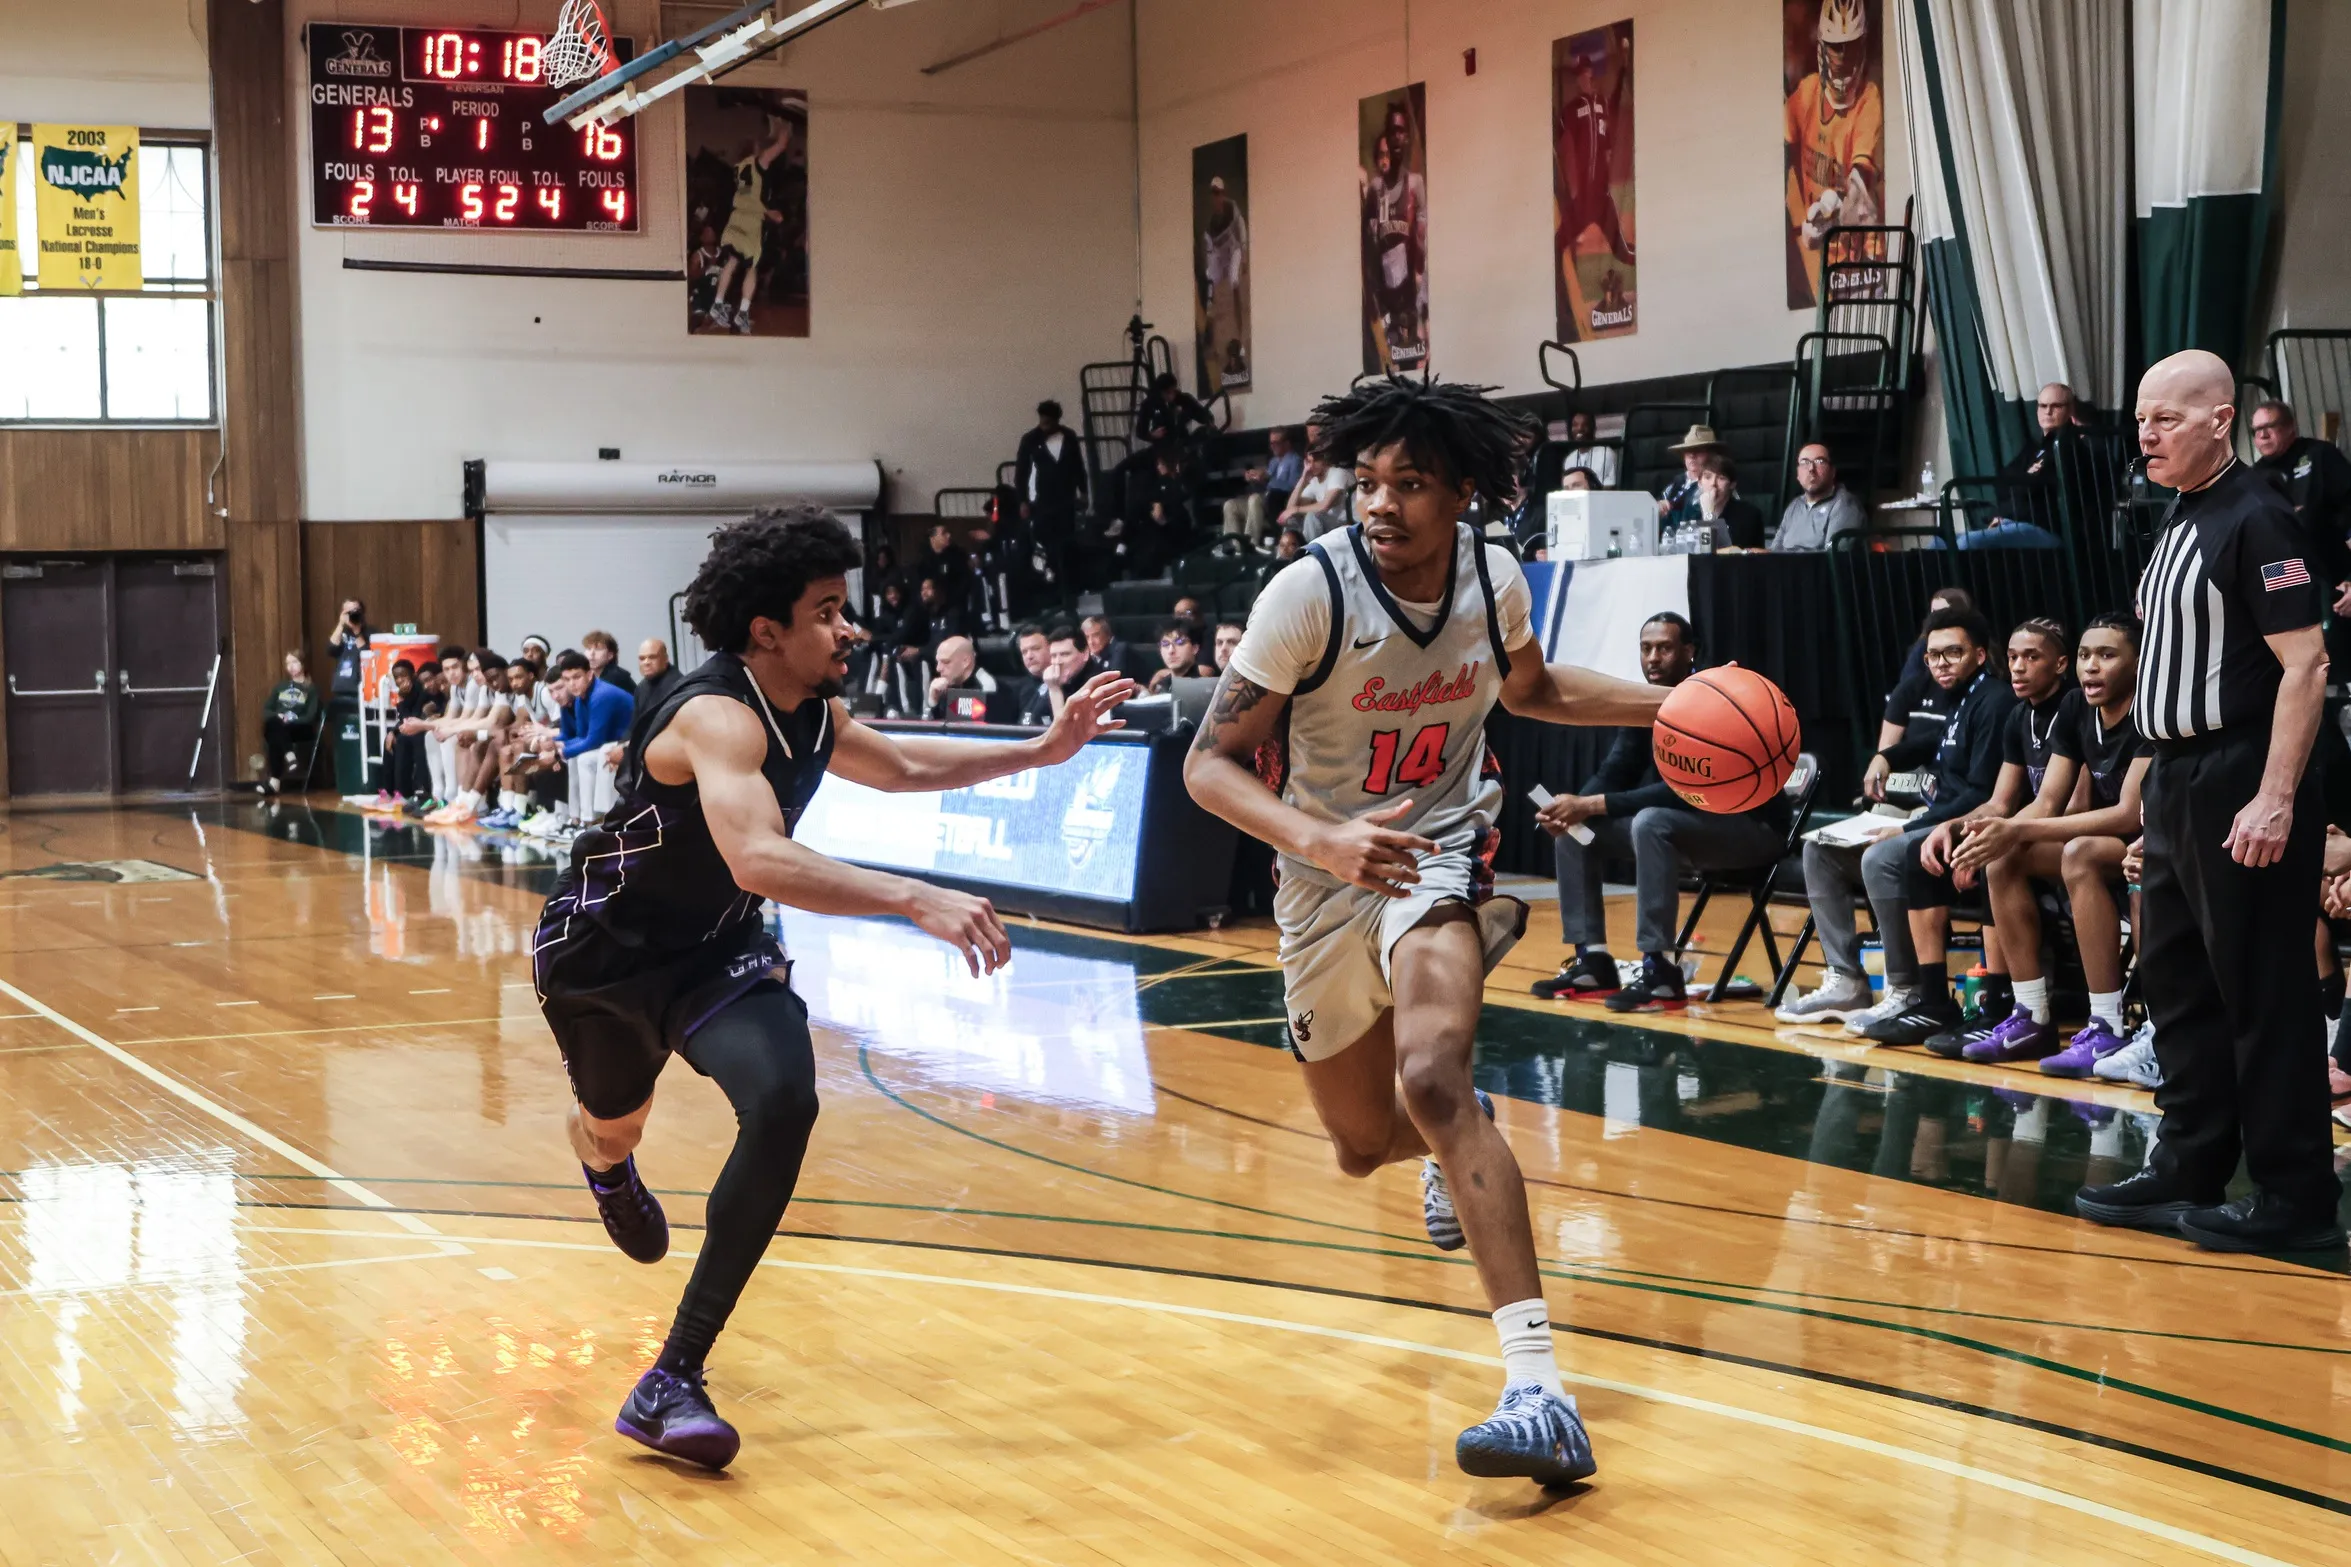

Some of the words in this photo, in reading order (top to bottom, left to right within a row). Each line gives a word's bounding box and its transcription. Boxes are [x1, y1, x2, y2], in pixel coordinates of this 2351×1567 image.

[425, 33, 541, 82] 10:18
[326, 57, 391, 76] GENERALS
[312, 83, 414, 108] GENERALS
[452, 100, 500, 117] PERIOD
[355, 107, 394, 152] 13
[420, 118, 429, 130] P
[521, 121, 531, 134] P
[67, 130, 106, 146] 2003
[420, 134, 431, 147] B
[479, 119, 488, 149] 1
[585, 120, 622, 160] 16
[522, 138, 532, 150] B
[47, 165, 121, 185] NJCAA
[325, 163, 375, 181] FOULS
[389, 167, 423, 182] T.O.L.
[436, 168, 484, 184] PLAYER
[489, 170, 523, 185] FOUL
[579, 171, 625, 188] FOULS
[351, 181, 373, 216] 2
[395, 184, 417, 215] 4
[539, 188, 560, 219] 4
[604, 190, 625, 221] 4
[73, 207, 105, 220] Men's
[332, 214, 370, 225] SCORE
[66, 224, 113, 237] Lacrosse
[443, 217, 480, 228] MATCH
[586, 221, 621, 231] SCORE
[41, 240, 82, 253] National
[85, 241, 139, 255] Champions
[79, 257, 102, 269] 18-0
[1592, 305, 1632, 327] GENERALS
[658, 474, 716, 483] RAYNOR
[1352, 660, 1479, 717] Eastfield
[958, 697, 972, 715] POSS
[1361, 721, 1450, 795] 14
